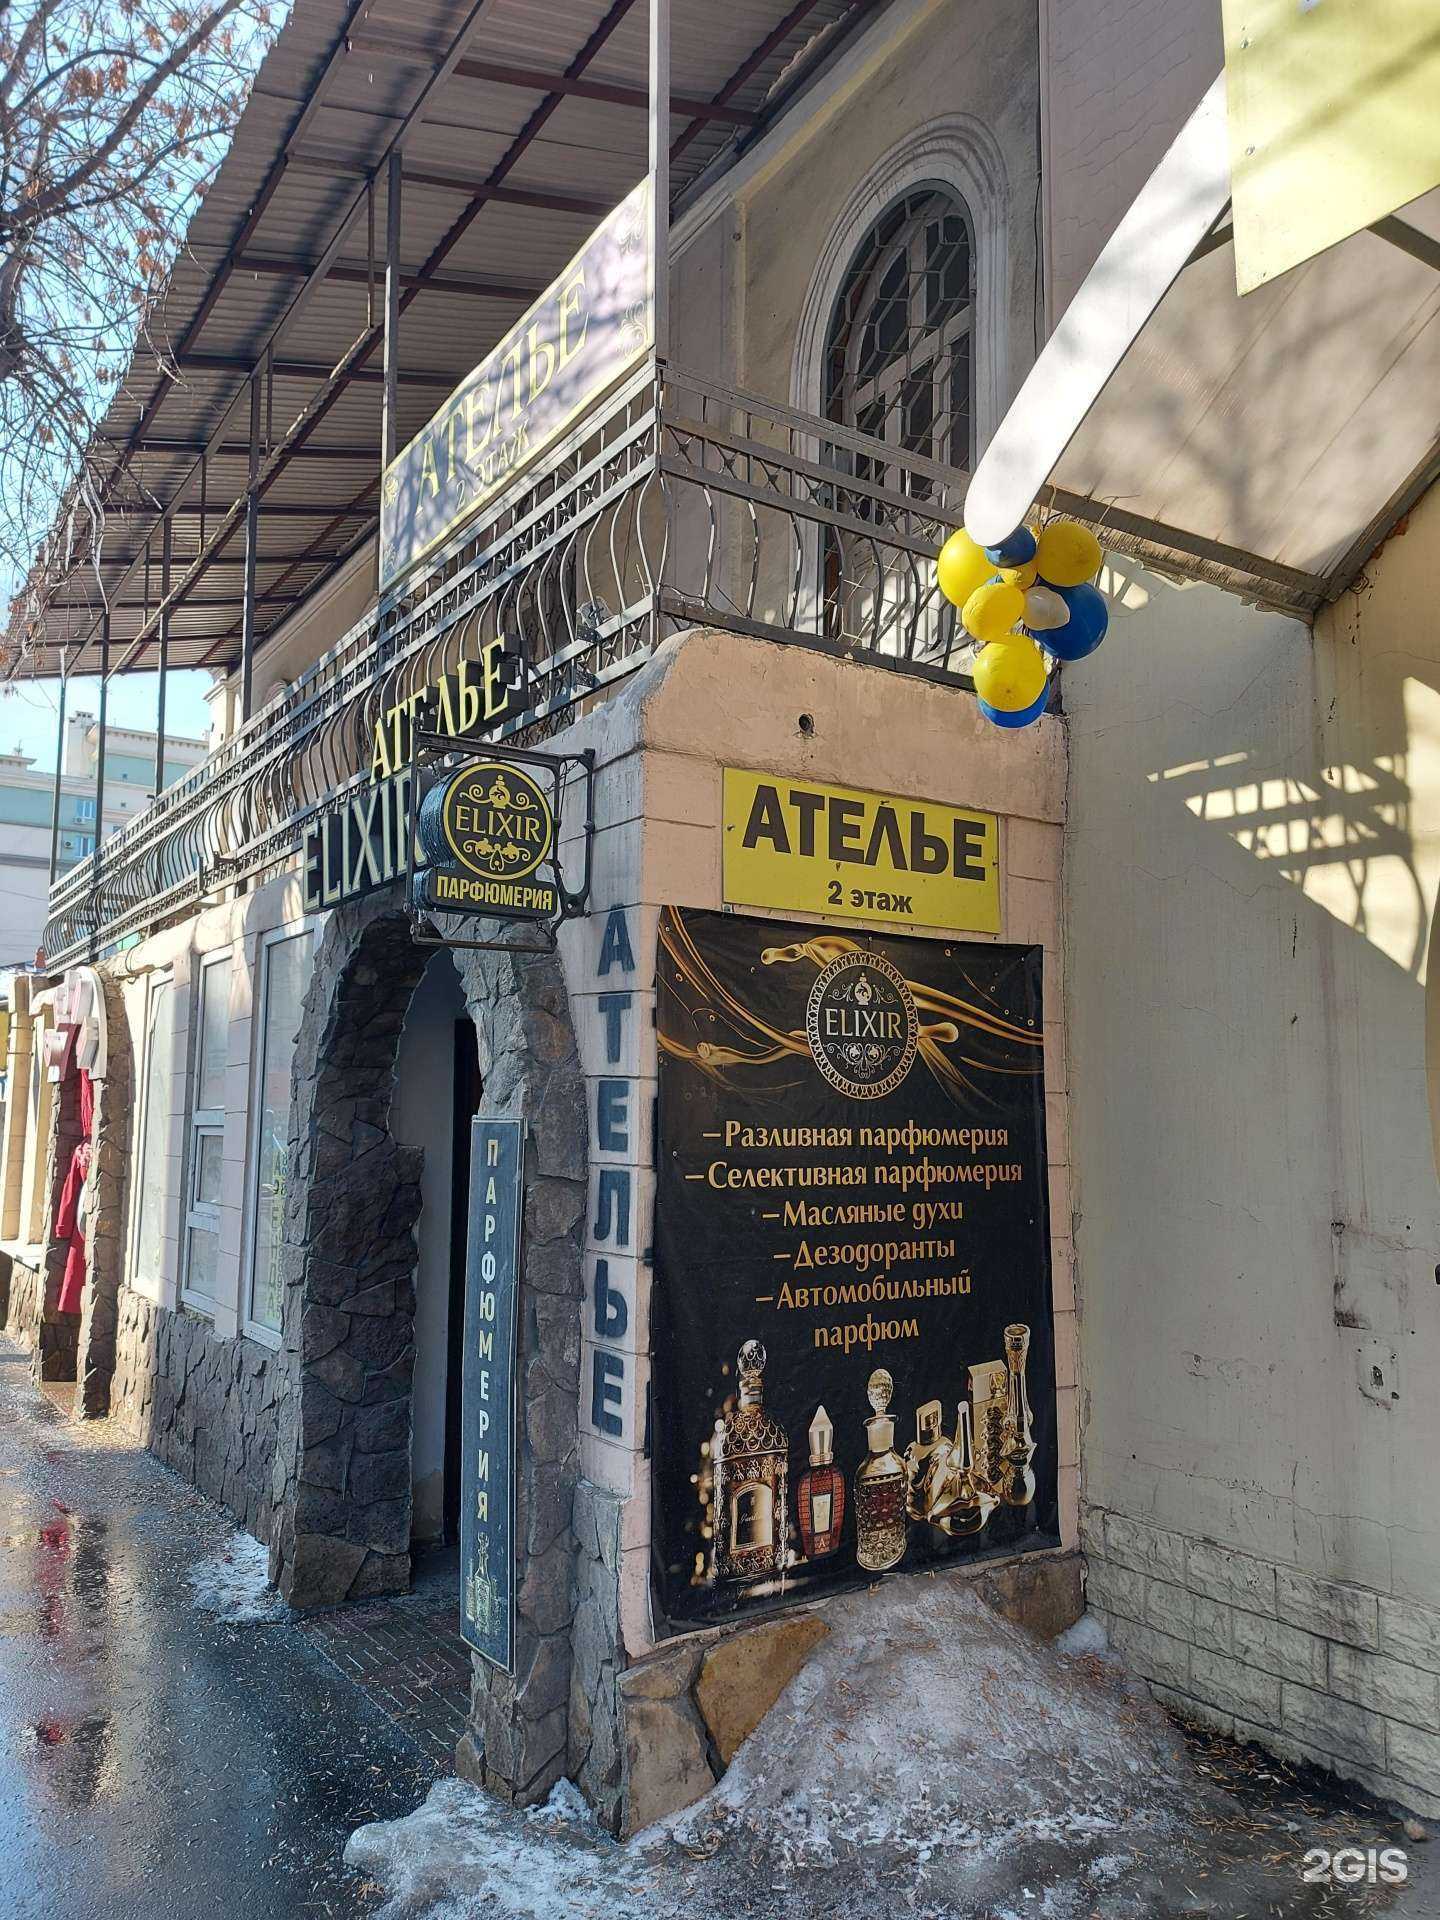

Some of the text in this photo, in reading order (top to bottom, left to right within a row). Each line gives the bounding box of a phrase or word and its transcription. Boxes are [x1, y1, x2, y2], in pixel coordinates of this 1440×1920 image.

[415, 267, 590, 515] АТЕЛЬЕ
[455, 422, 531, 508] 2 ЭТАЖ
[303, 769, 427, 912] ELIXIR
[455, 804, 542, 843] ELIXIR
[742, 784, 987, 882] АТЕЛЬЕ
[436, 875, 553, 911] ПАРФЮМЕРИЯ
[827, 879, 914, 914] 2 этаж
[825, 1007, 903, 1039] ELIXIR
[859, 1119, 1009, 1155] парфюмерия
[592, 903, 636, 1437] АТЕЛЬЕ
[874, 1156, 1023, 1193] парфюмерия
[912, 1201, 964, 1230] духи
[476, 1138, 499, 1522] ПАРФЮМЕРИЯ
[814, 1313, 920, 1354] парфюм
